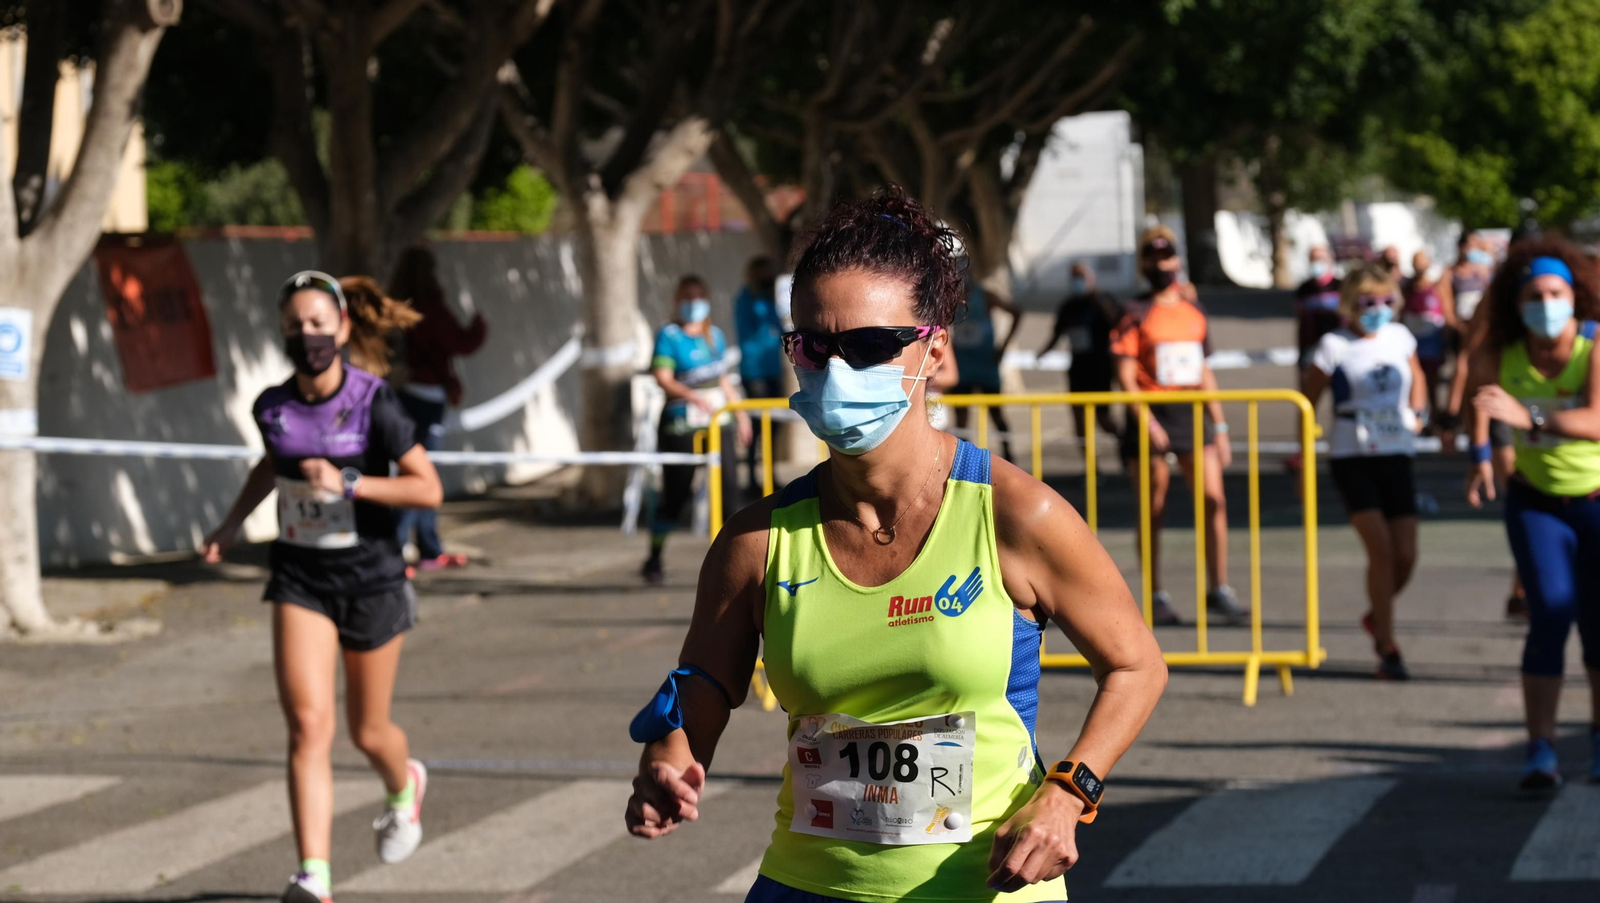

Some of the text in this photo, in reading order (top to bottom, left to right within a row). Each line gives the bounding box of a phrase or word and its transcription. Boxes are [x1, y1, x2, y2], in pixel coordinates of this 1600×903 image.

[887, 595, 963, 618] Run 04
[888, 614, 935, 628] atletismo
[832, 728, 876, 740] CARRERAS
[878, 728, 923, 741] POPULARES
[804, 751, 813, 762] C
[839, 741, 919, 783] 108
[930, 767, 956, 798] R
[863, 784, 899, 805] INMA
